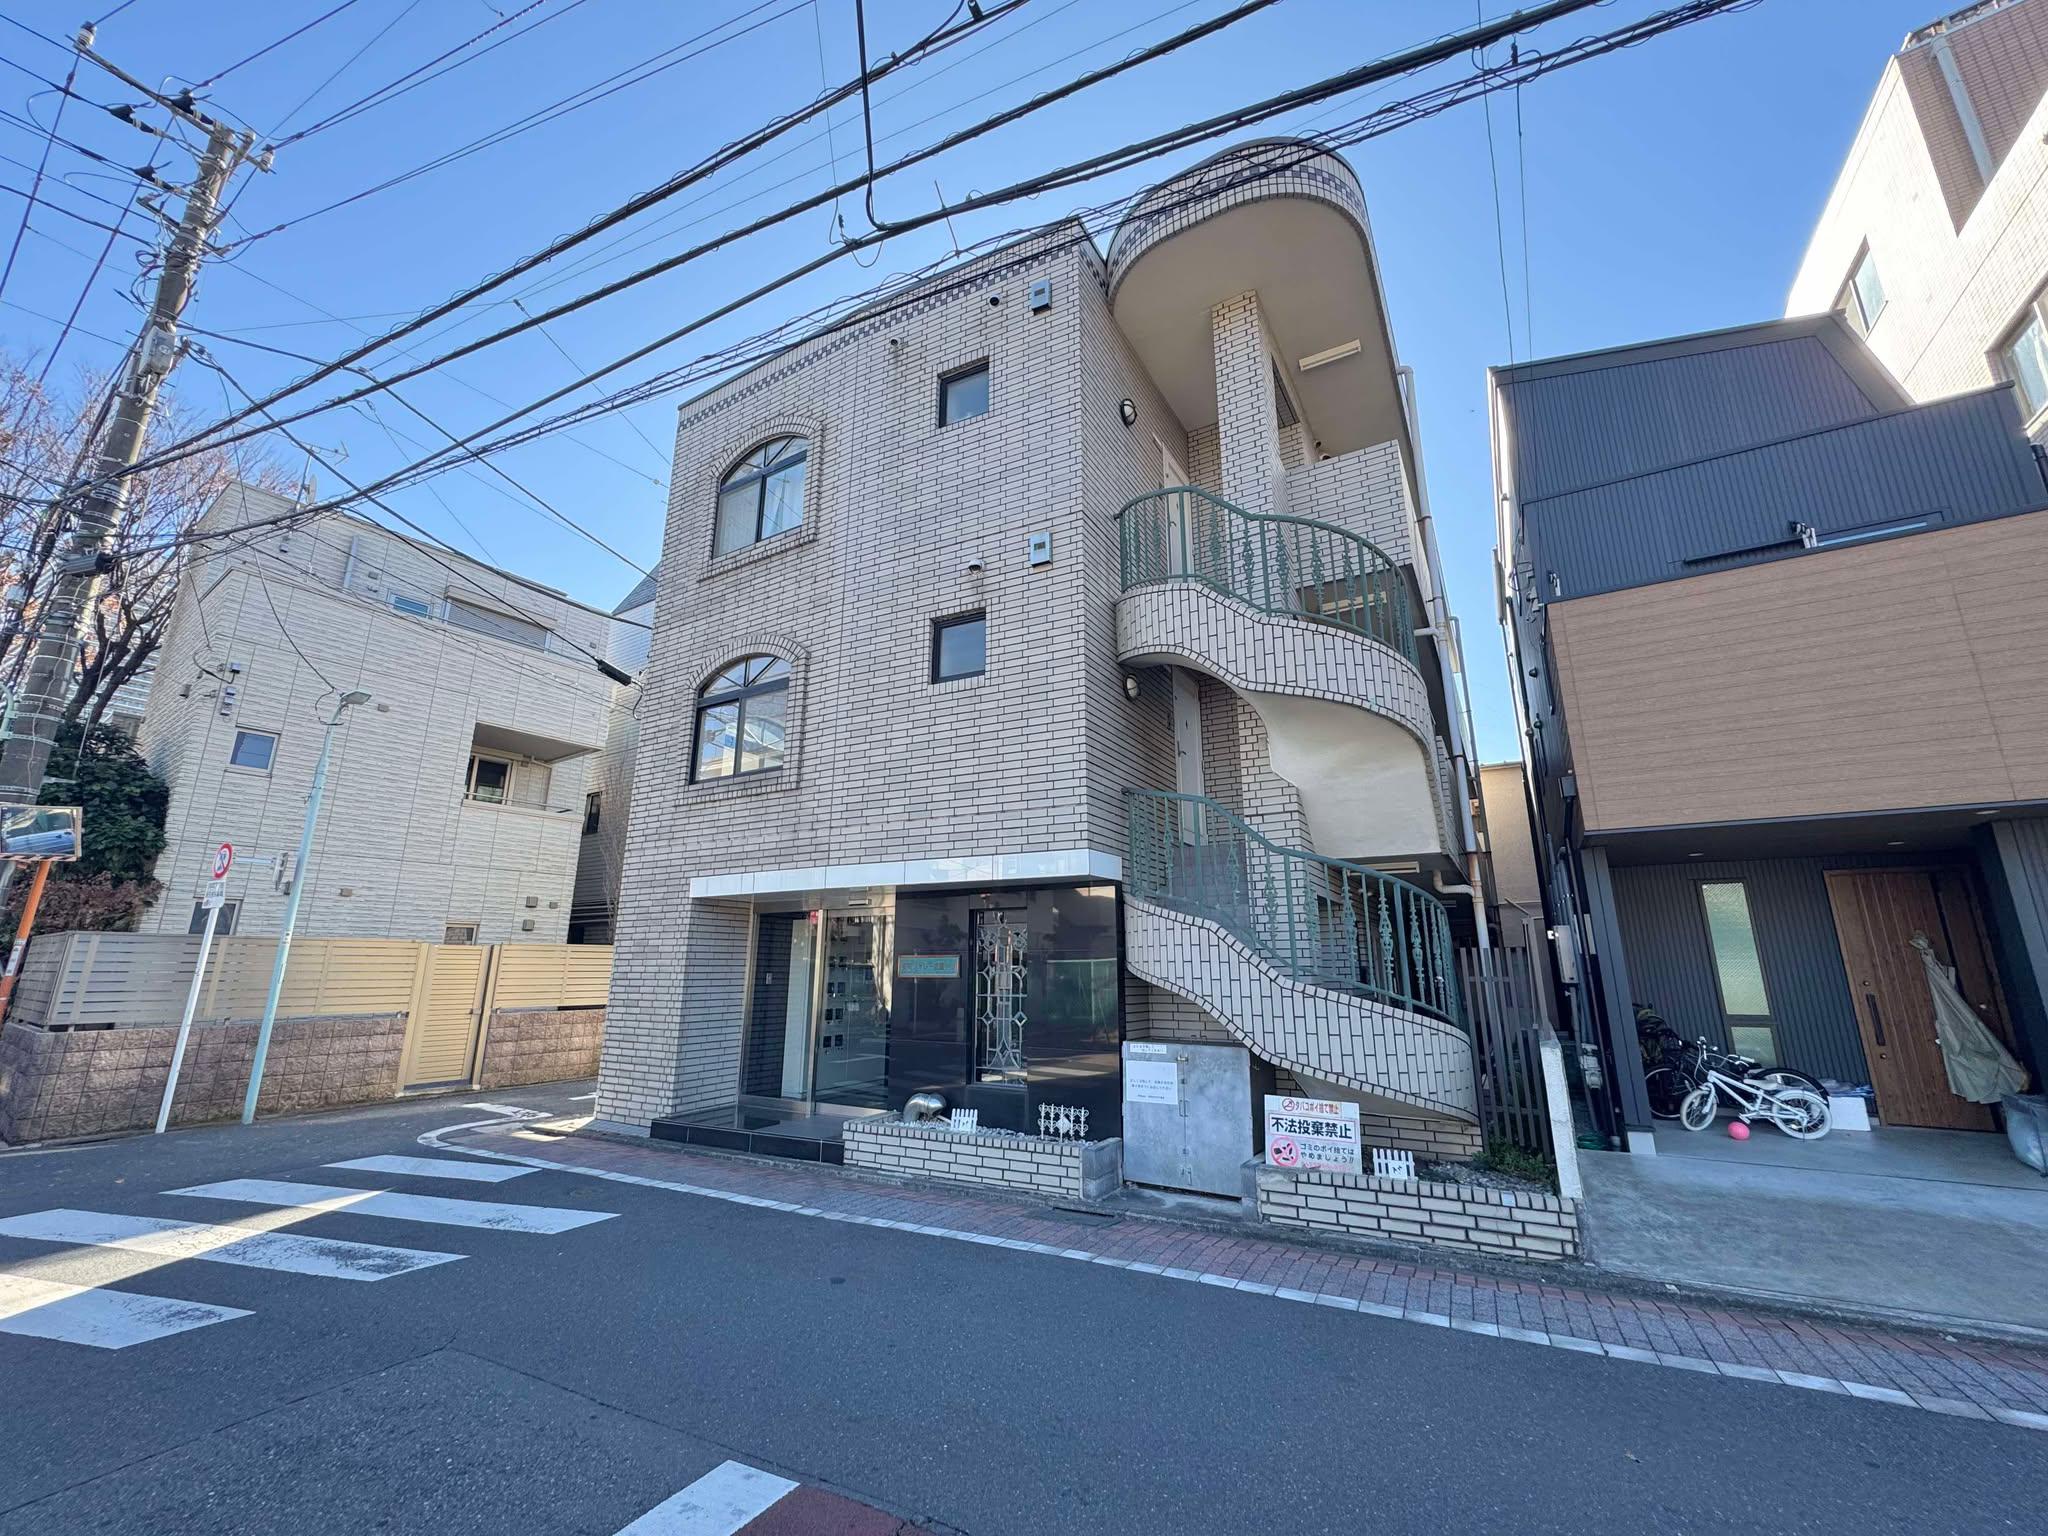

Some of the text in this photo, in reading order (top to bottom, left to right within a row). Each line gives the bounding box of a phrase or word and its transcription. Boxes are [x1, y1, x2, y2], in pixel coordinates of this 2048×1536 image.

[1271, 1117, 1352, 1139] 不法投棄禁止
[1300, 1143, 1355, 1155] ゴミのポイ捨ては
